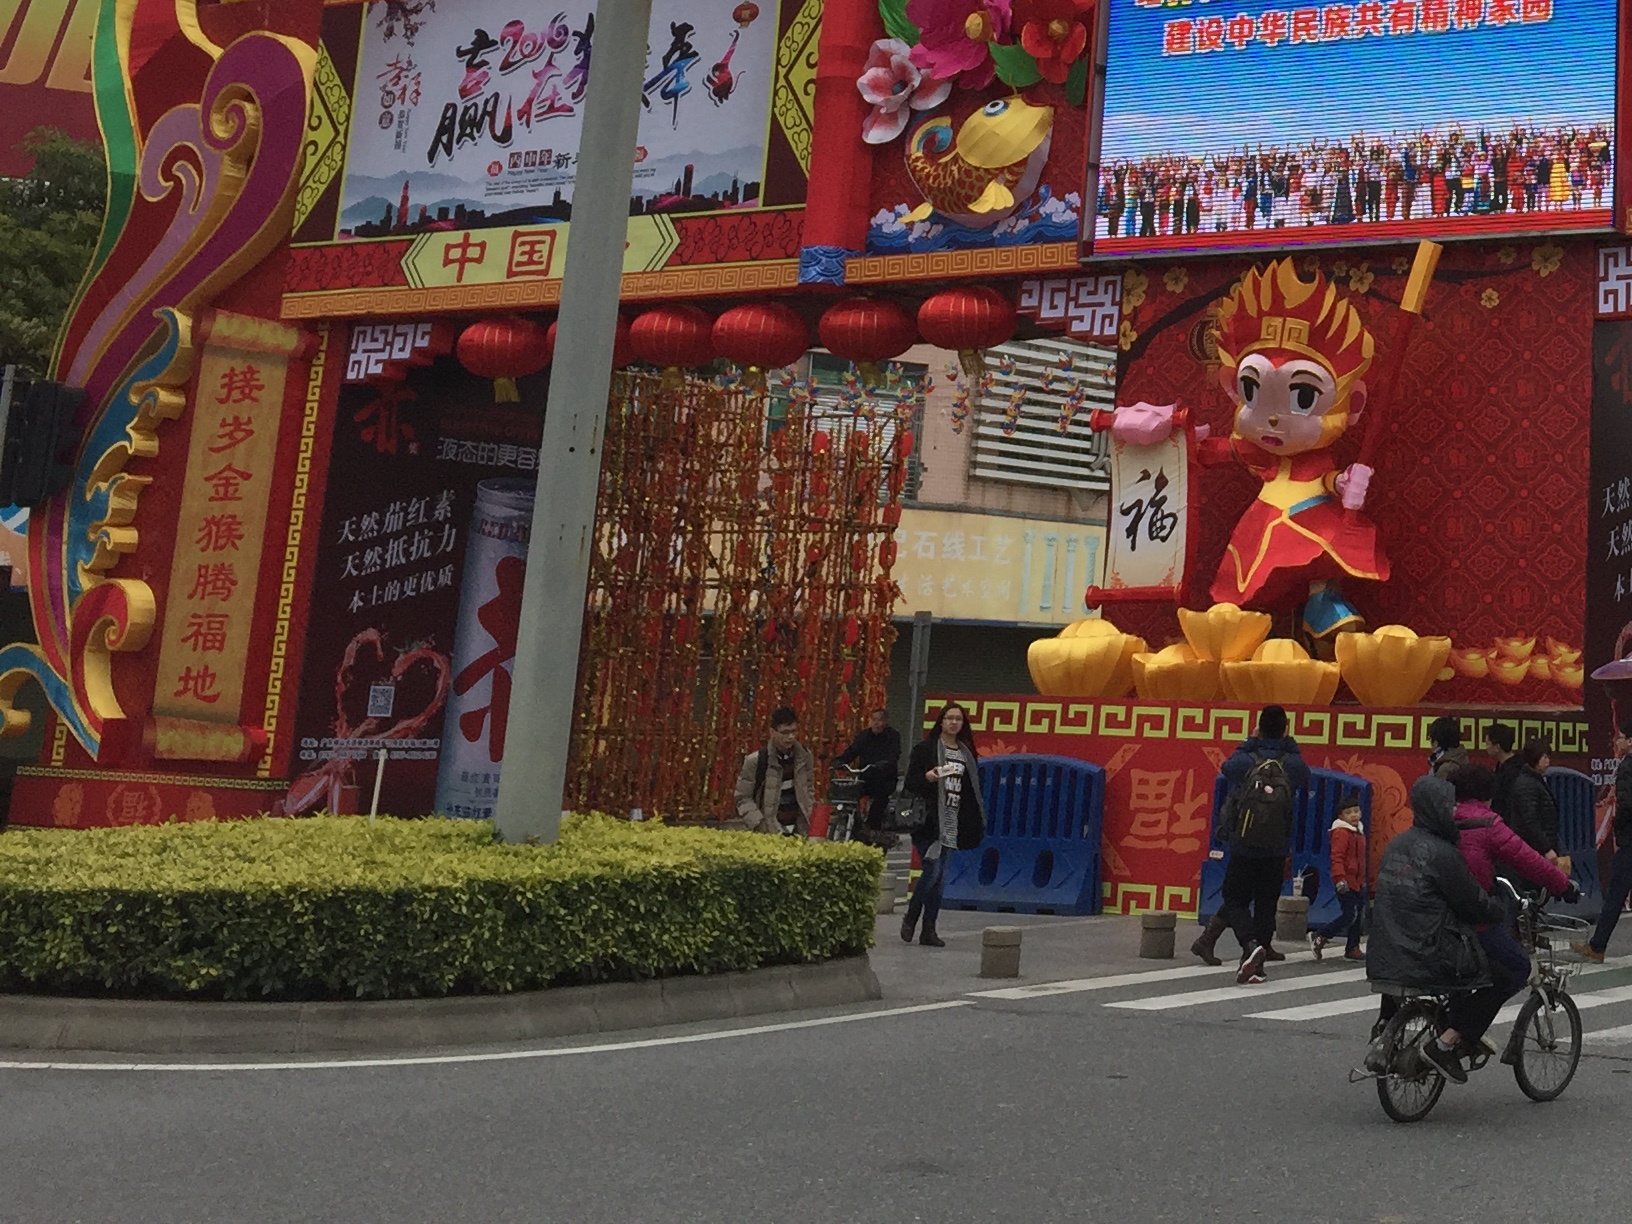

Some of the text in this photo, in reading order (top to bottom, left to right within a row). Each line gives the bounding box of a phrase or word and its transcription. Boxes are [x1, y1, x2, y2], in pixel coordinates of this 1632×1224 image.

[442, 229, 630, 284] 中国
[435, 437, 541, 470] 液态的更容
[174, 366, 265, 704] 接岁金猴腾福地
[336, 489, 457, 545] 天然茄红素
[1120, 469, 1179, 552] 福
[339, 523, 457, 581] 天然抵抗力
[347, 563, 455, 614] 本土的更优质
